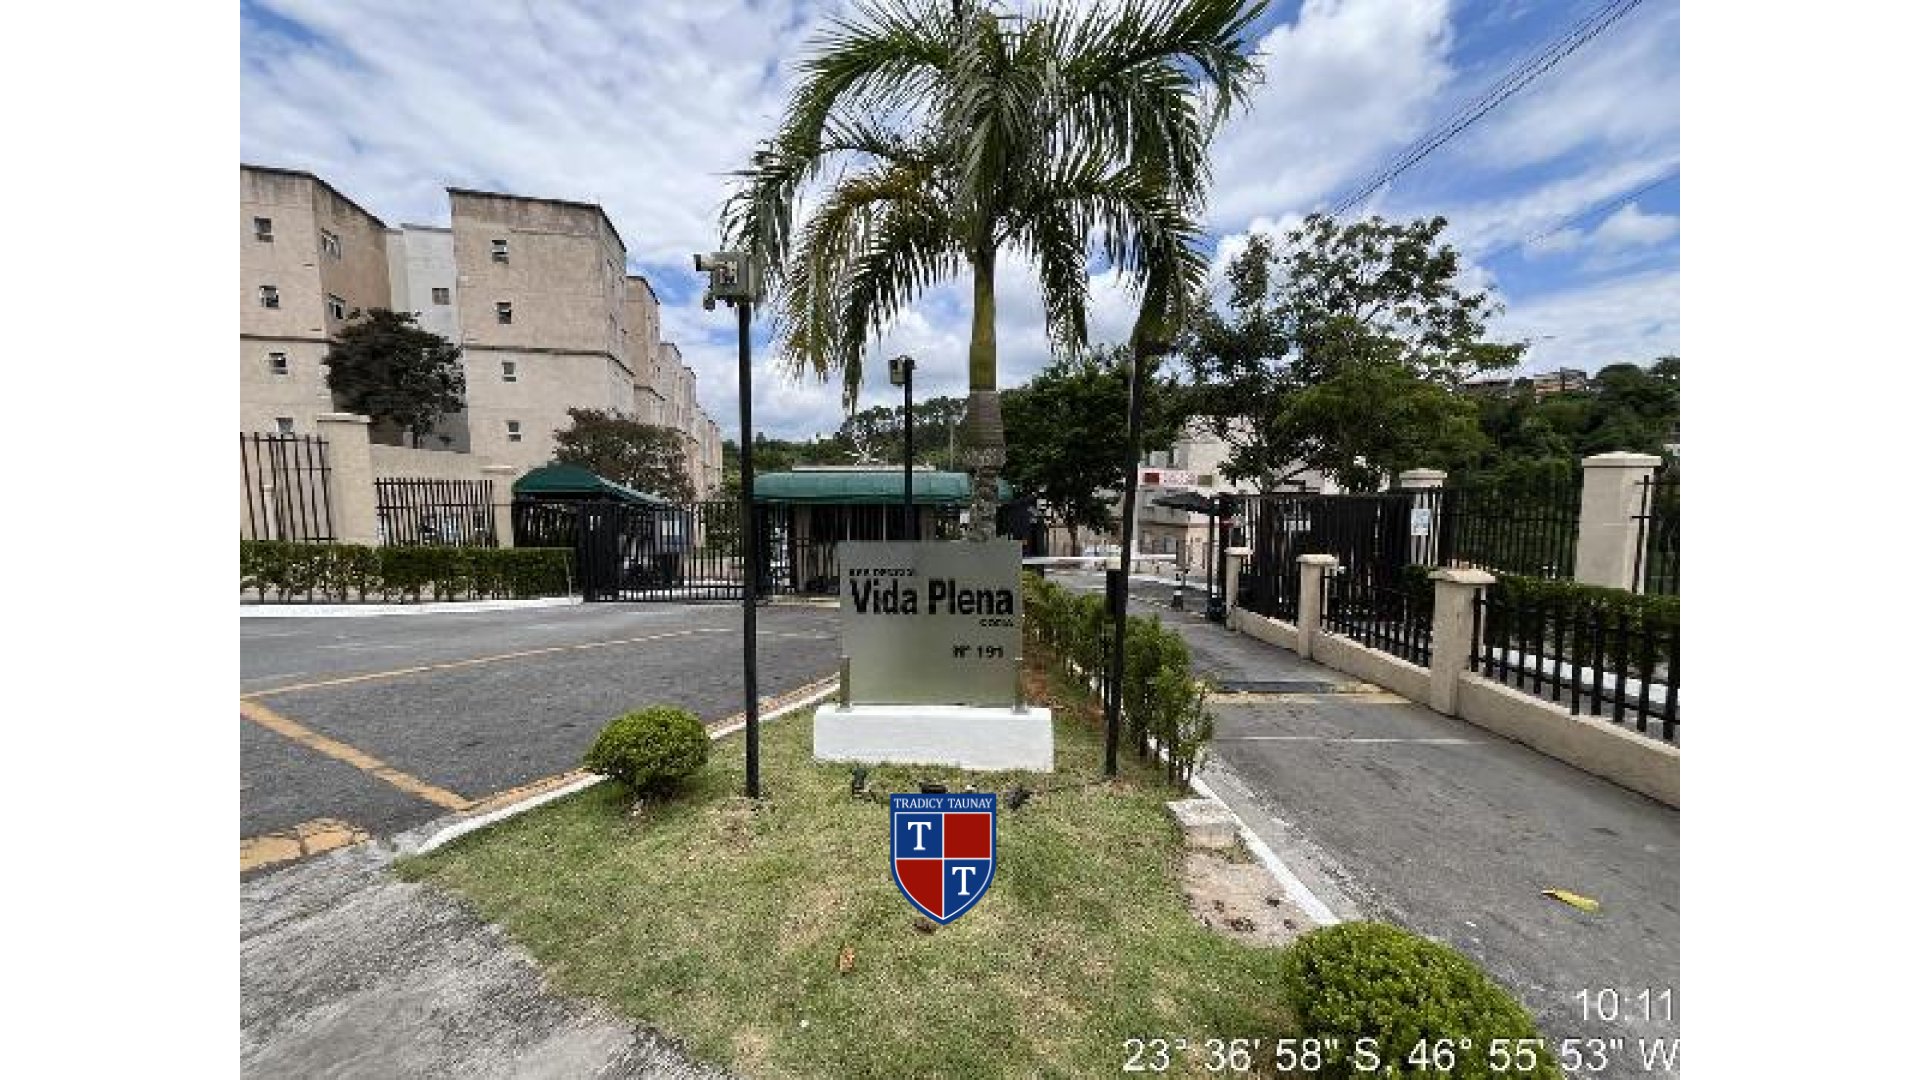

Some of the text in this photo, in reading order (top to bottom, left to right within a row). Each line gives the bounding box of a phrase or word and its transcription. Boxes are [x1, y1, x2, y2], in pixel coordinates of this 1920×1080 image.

[849, 577, 1014, 616] Vida Plena
[976, 645, 1004, 659] 191
